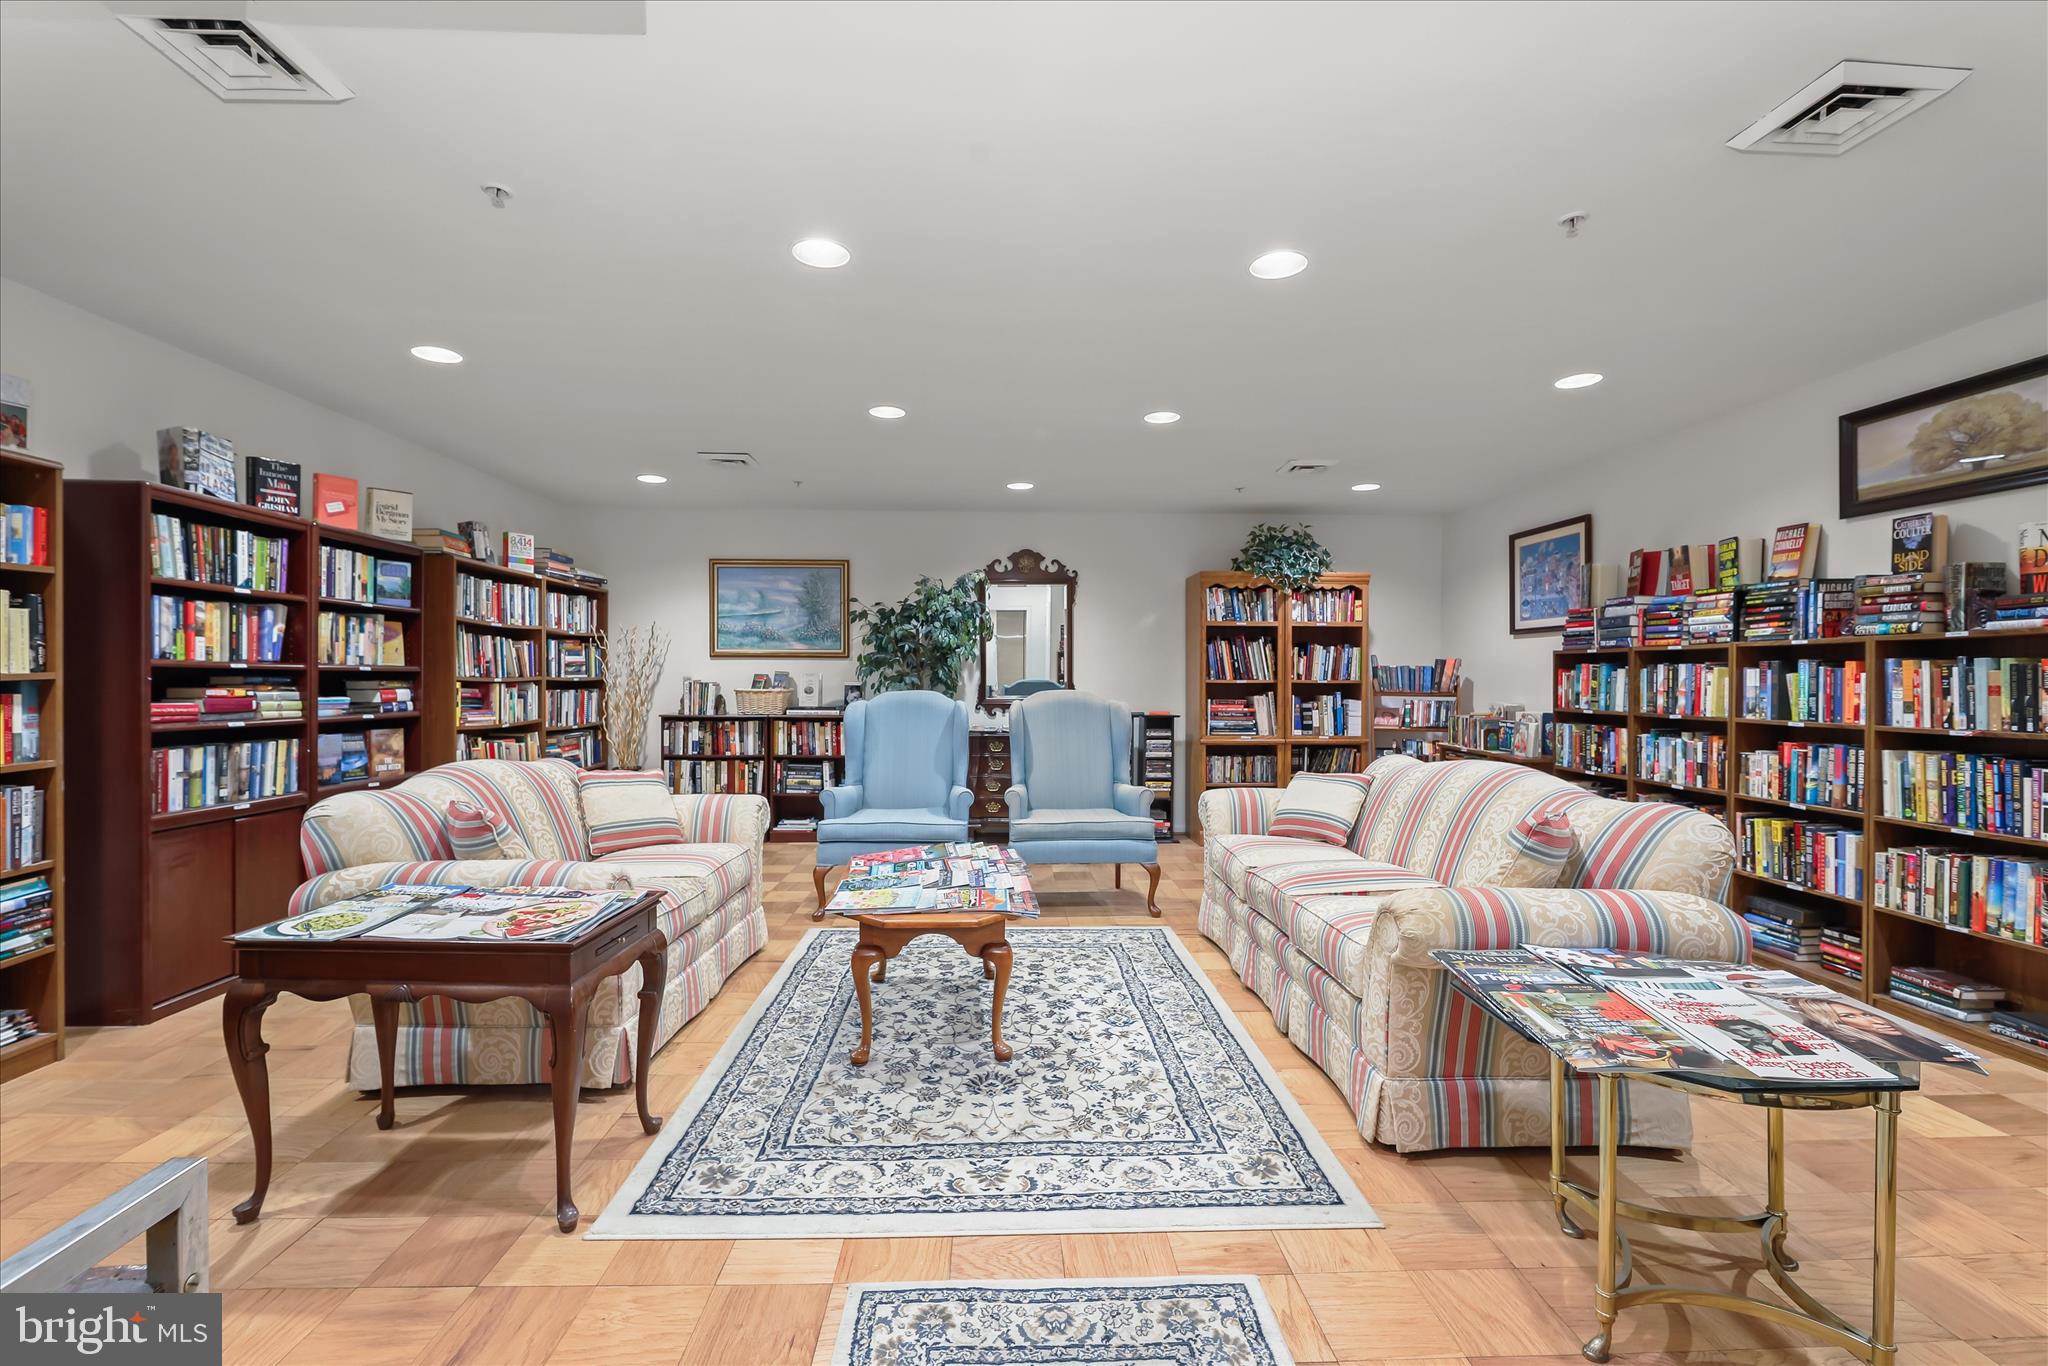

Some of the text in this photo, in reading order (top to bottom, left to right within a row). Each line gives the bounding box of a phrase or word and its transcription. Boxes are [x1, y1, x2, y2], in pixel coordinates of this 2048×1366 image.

[271, 463, 288, 472] The
[259, 467, 298, 481] Innocent
[267, 478, 291, 490] Man
[265, 495, 290, 505] JOHN
[258, 502, 298, 514] GRISHAM
[376, 502, 399, 511] Ingrid
[376, 508, 409, 519] Bergman
[1894, 514, 1932, 530] CATHERINE
[1776, 527, 1805, 541] MICHAEL
[1893, 527, 1932, 540] COULTER
[1774, 537, 1804, 552] CONNELLY
[1894, 549, 1930, 564] BLIND
[1898, 560, 1924, 572] SIDE
[1671, 579, 1690, 591] TARGET
[1819, 583, 1854, 592] MICHAE
[1883, 585, 1912, 594] LABYRINTH
[1882, 603, 1912, 612] DEADLOCK
[1985, 783, 1994, 808] EVANOVICH
[1448, 953, 1523, 964] NATURE
[1790, 1040, 1841, 1053] Story
[1786, 1058, 1856, 1070] Epstein
